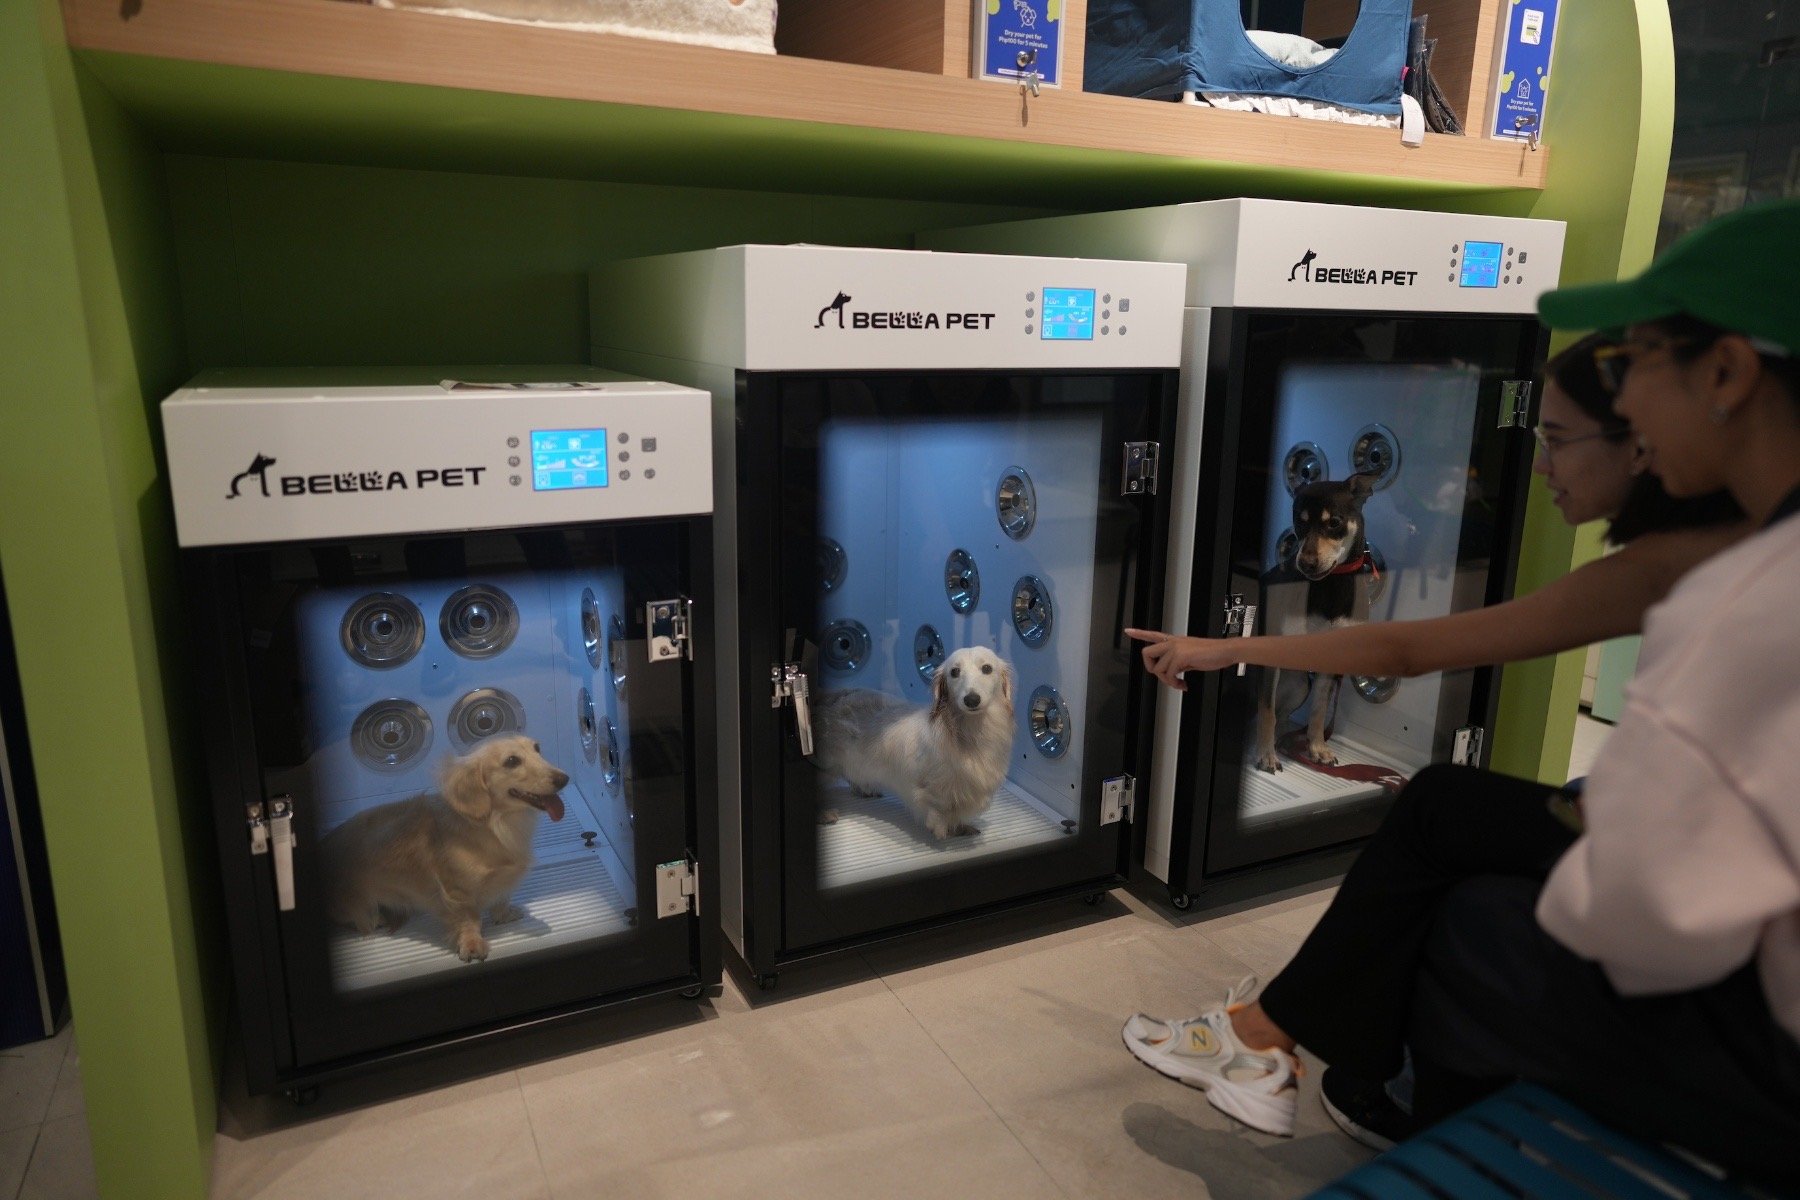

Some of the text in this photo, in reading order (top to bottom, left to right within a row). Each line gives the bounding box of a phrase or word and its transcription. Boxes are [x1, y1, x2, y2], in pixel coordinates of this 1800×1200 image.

[1004, 29, 1014, 37] Dry
[1029, 41, 1048, 49] minutes
[1315, 267, 1418, 286] BELLA PET
[852, 311, 996, 330] BELLA PET
[280, 467, 487, 497] BELLA PET
[1192, 1030, 1207, 1047] N
